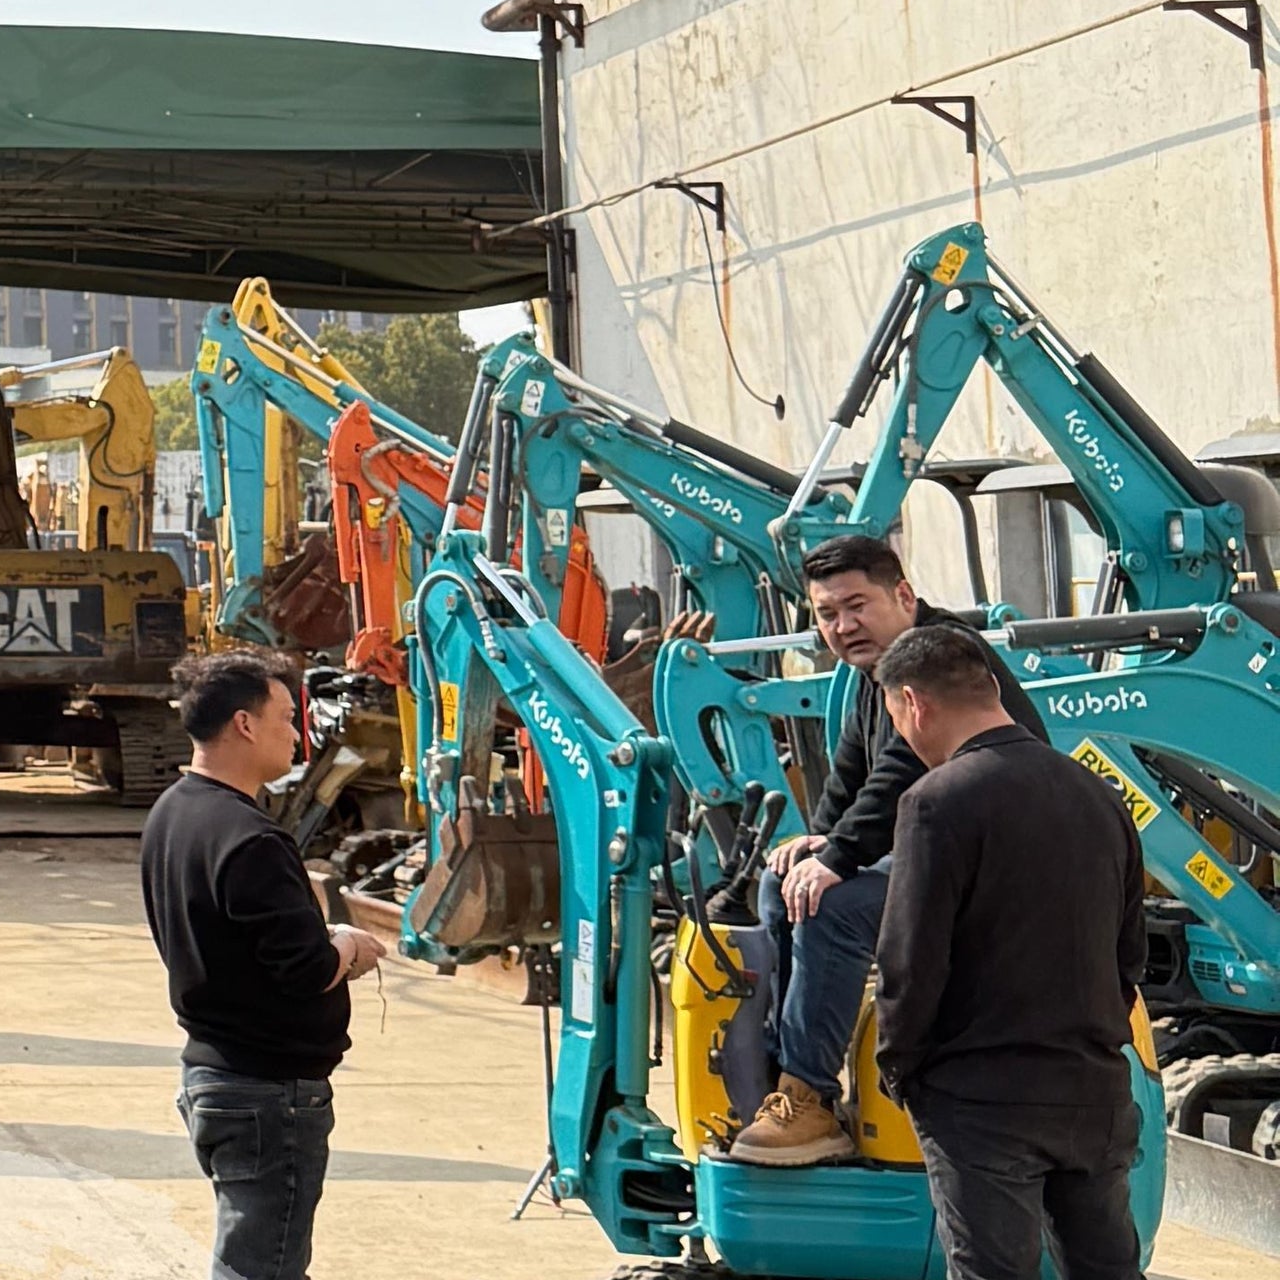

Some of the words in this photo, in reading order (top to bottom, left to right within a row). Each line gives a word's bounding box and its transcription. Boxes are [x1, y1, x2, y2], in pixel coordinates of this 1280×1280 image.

[1063, 408, 1125, 492] Kubota
[671, 473, 742, 524] Kubota
[528, 690, 590, 780] Kubota
[1048, 686, 1148, 718] Kubota
